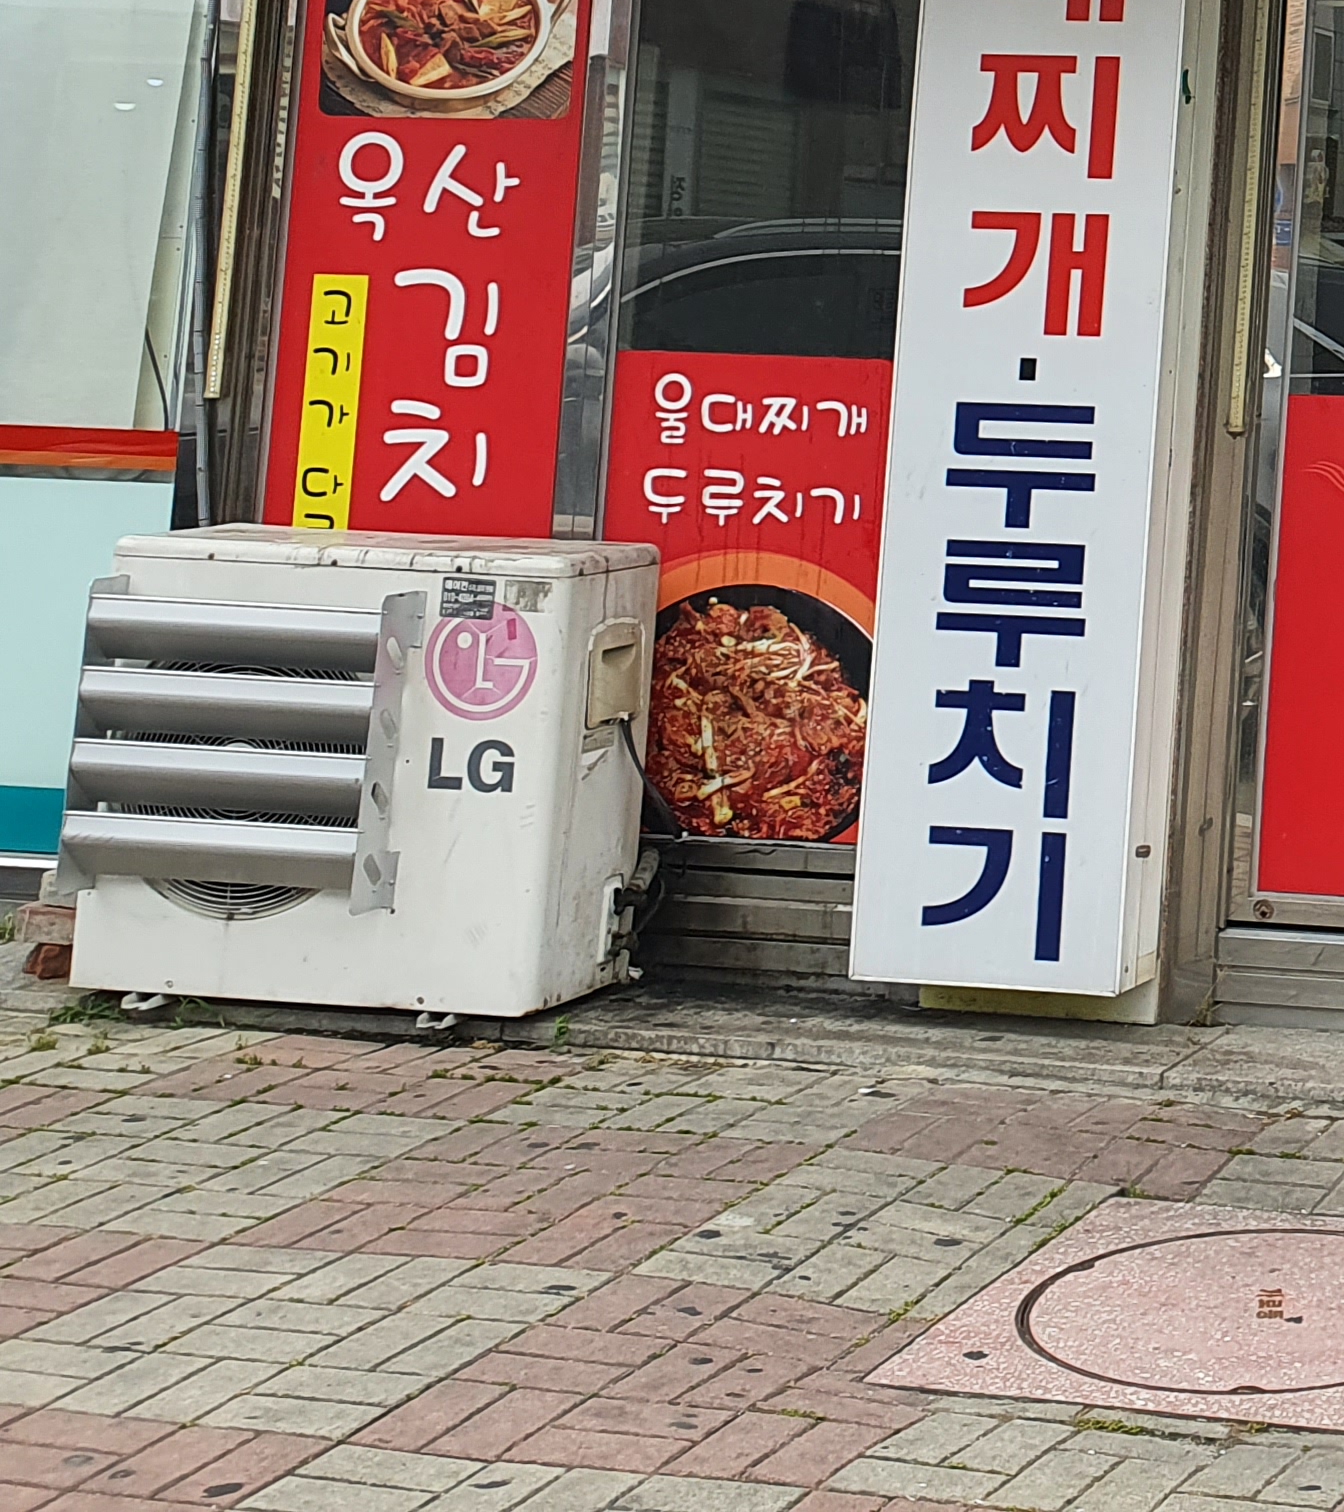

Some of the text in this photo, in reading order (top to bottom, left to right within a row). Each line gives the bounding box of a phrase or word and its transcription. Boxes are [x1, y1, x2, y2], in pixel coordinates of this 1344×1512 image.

[337, 130, 522, 243] 옥산
[379, 267, 502, 504] 김치
[651, 371, 870, 448] 울대찌개
[642, 467, 862, 527] 두루치기
[426, 738, 516, 794] LG
